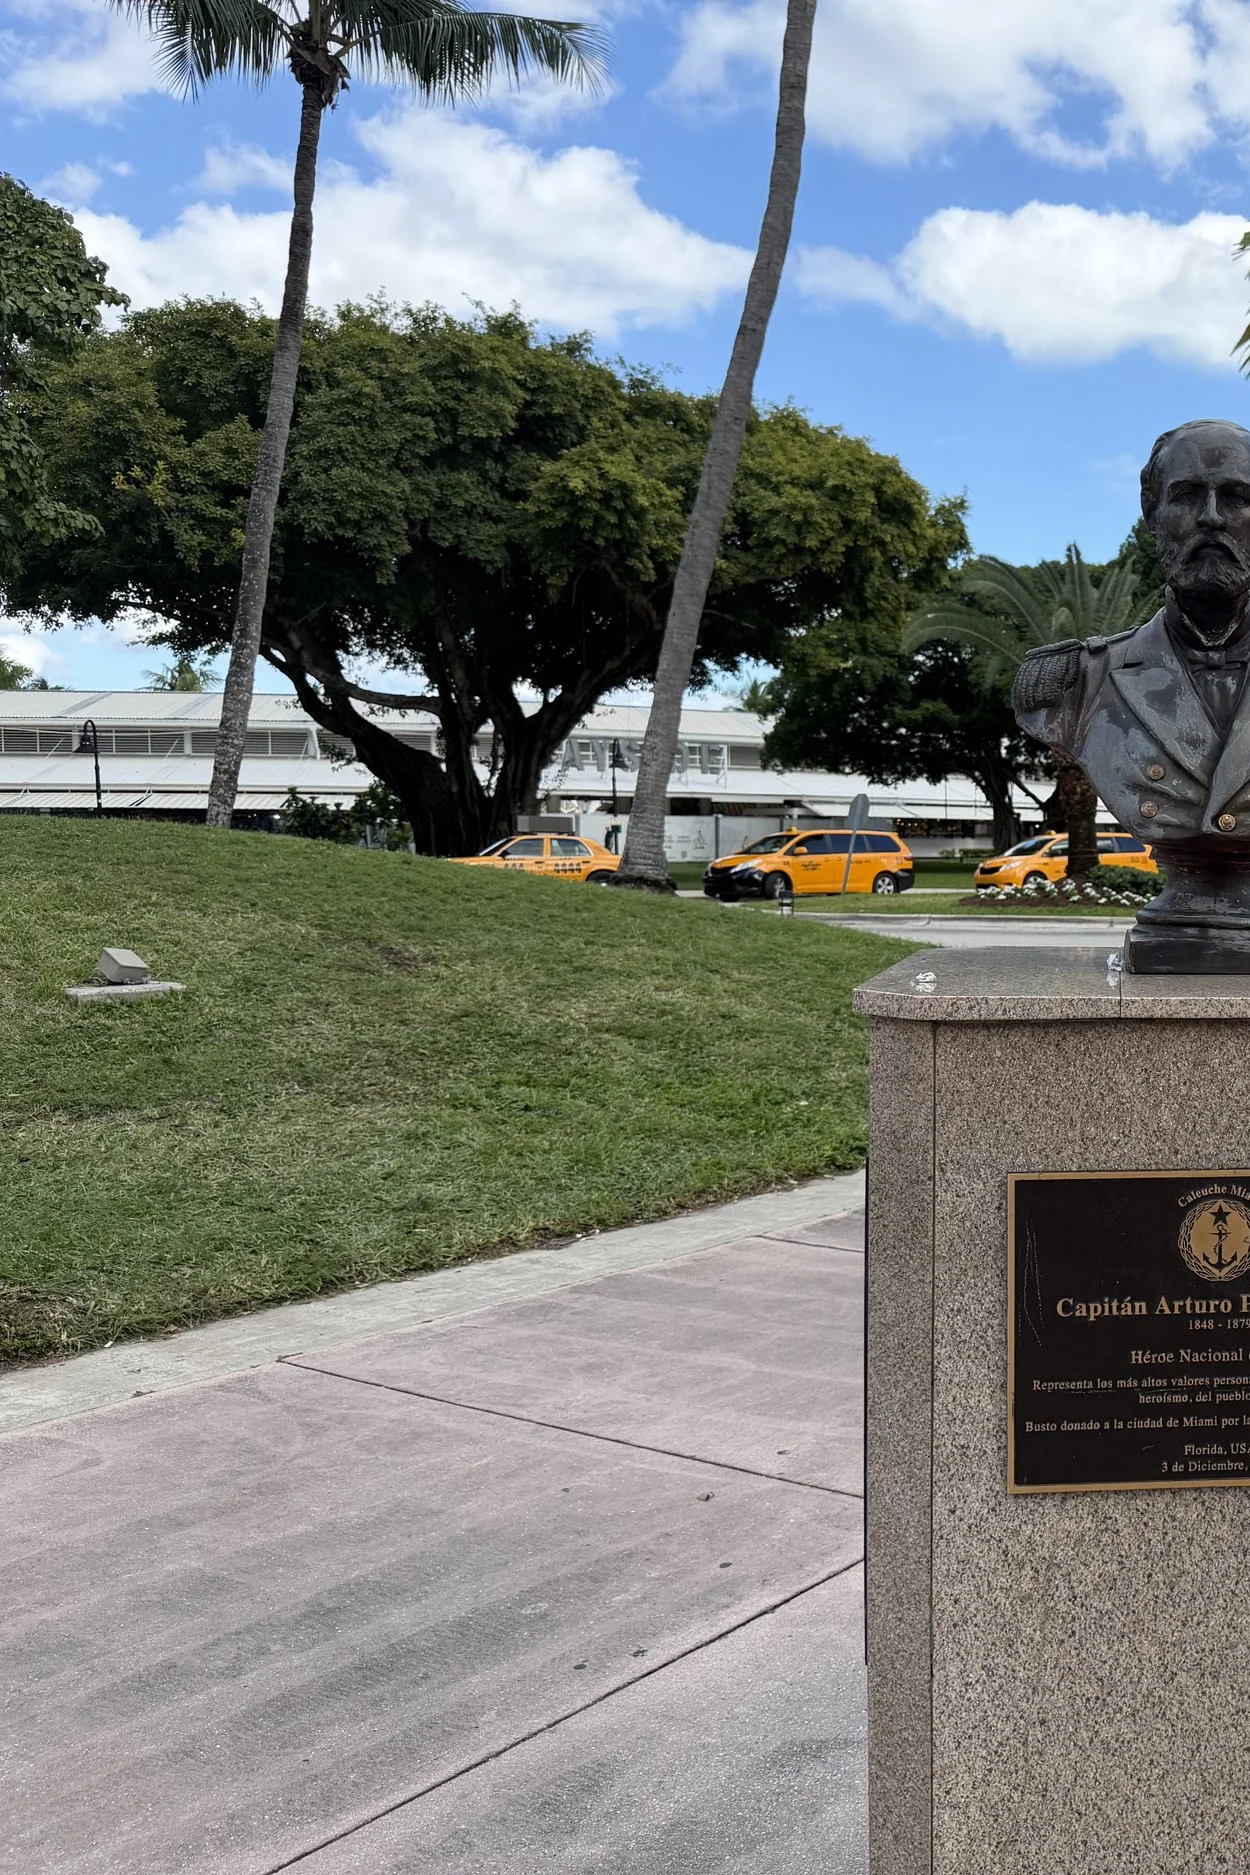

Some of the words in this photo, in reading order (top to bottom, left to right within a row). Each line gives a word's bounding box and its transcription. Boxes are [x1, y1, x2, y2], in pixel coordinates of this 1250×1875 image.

[1177, 1183, 1227, 1207] Caleuche
[1056, 1294, 1147, 1321] Capitán
[1155, 1296, 1232, 1315] Arturo
[1188, 1319, 1214, 1330] 1848
[1130, 1350, 1175, 1364] Héroe
[1179, 1348, 1243, 1363] Nacional
[1032, 1379, 1094, 1392] Representa
[1096, 1379, 1113, 1390] los
[1116, 1378, 1140, 1390] más
[1141, 1377, 1168, 1388] altos
[1171, 1376, 1210, 1387] valores
[1195, 1391, 1212, 1402] del
[1025, 1421, 1057, 1432] Busto
[1060, 1420, 1100, 1431] donado
[1103, 1421, 1110, 1430] a
[1113, 1419, 1124, 1430] la
[1127, 1418, 1163, 1429] ciudad
[1166, 1417, 1179, 1428] de
[1182, 1416, 1218, 1427] Miami
[1221, 1418, 1240, 1429] por
[1184, 1444, 1227, 1456] Florida,
[1161, 1463, 1168, 1473] 3
[1171, 1461, 1184, 1472] de
[1188, 1460, 1248, 1473] Diciembre,
